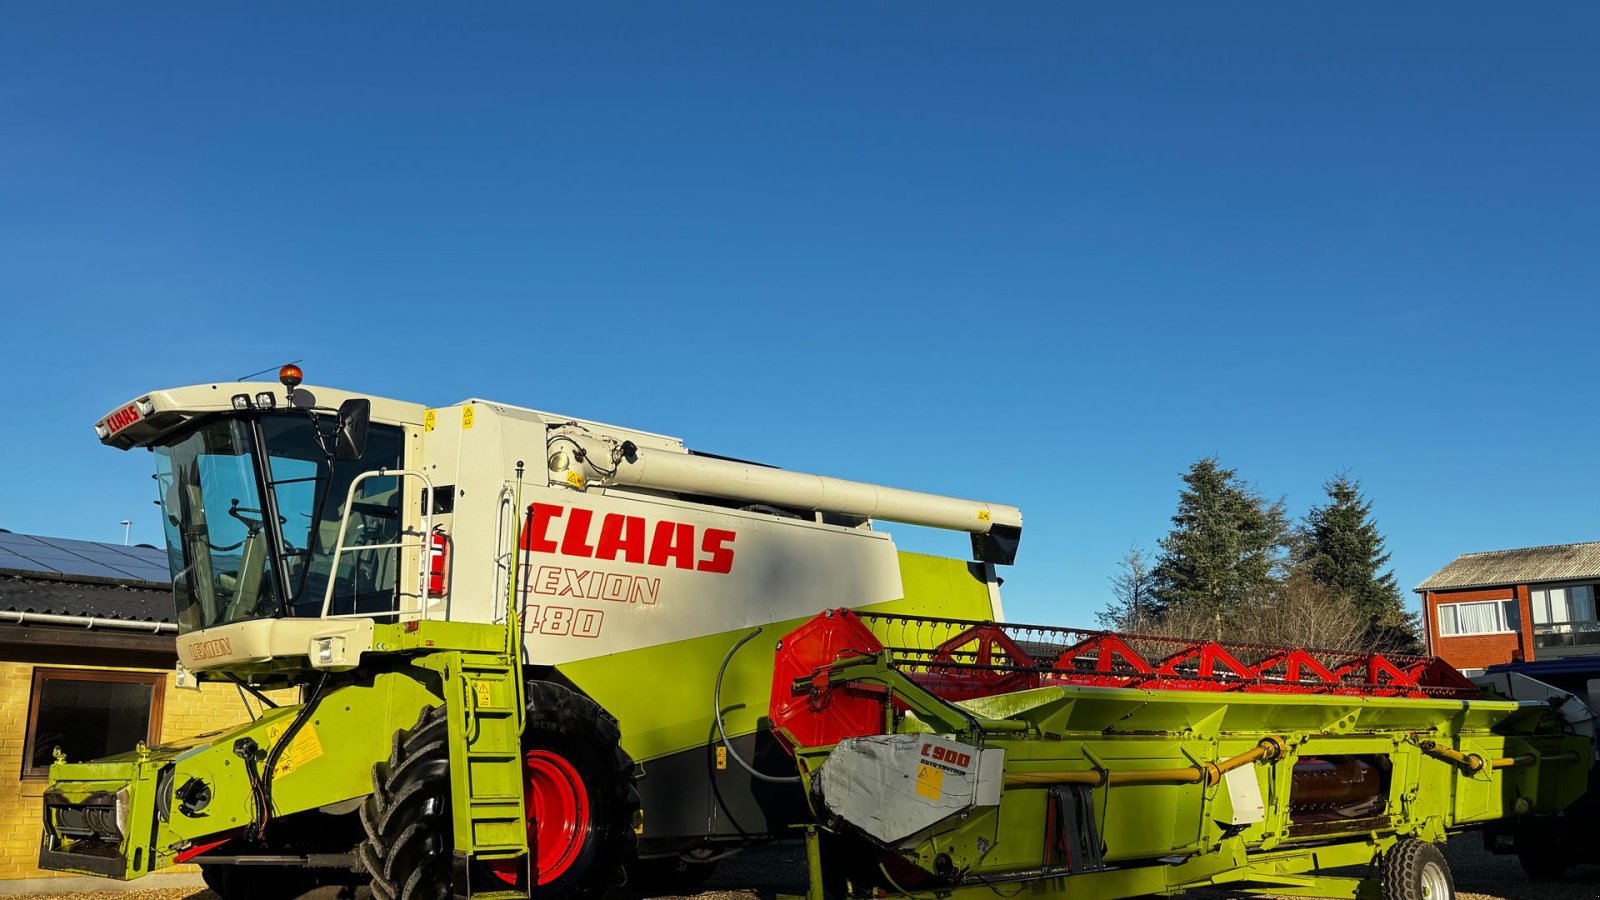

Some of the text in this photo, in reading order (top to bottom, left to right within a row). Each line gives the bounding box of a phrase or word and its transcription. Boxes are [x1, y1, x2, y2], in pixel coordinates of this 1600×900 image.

[106, 404, 140, 433] CLAAS
[520, 502, 736, 574] CLAAS
[516, 563, 661, 605] LEXION
[517, 604, 604, 639] 480
[188, 637, 233, 661] LEXION
[921, 743, 971, 768] C 900
